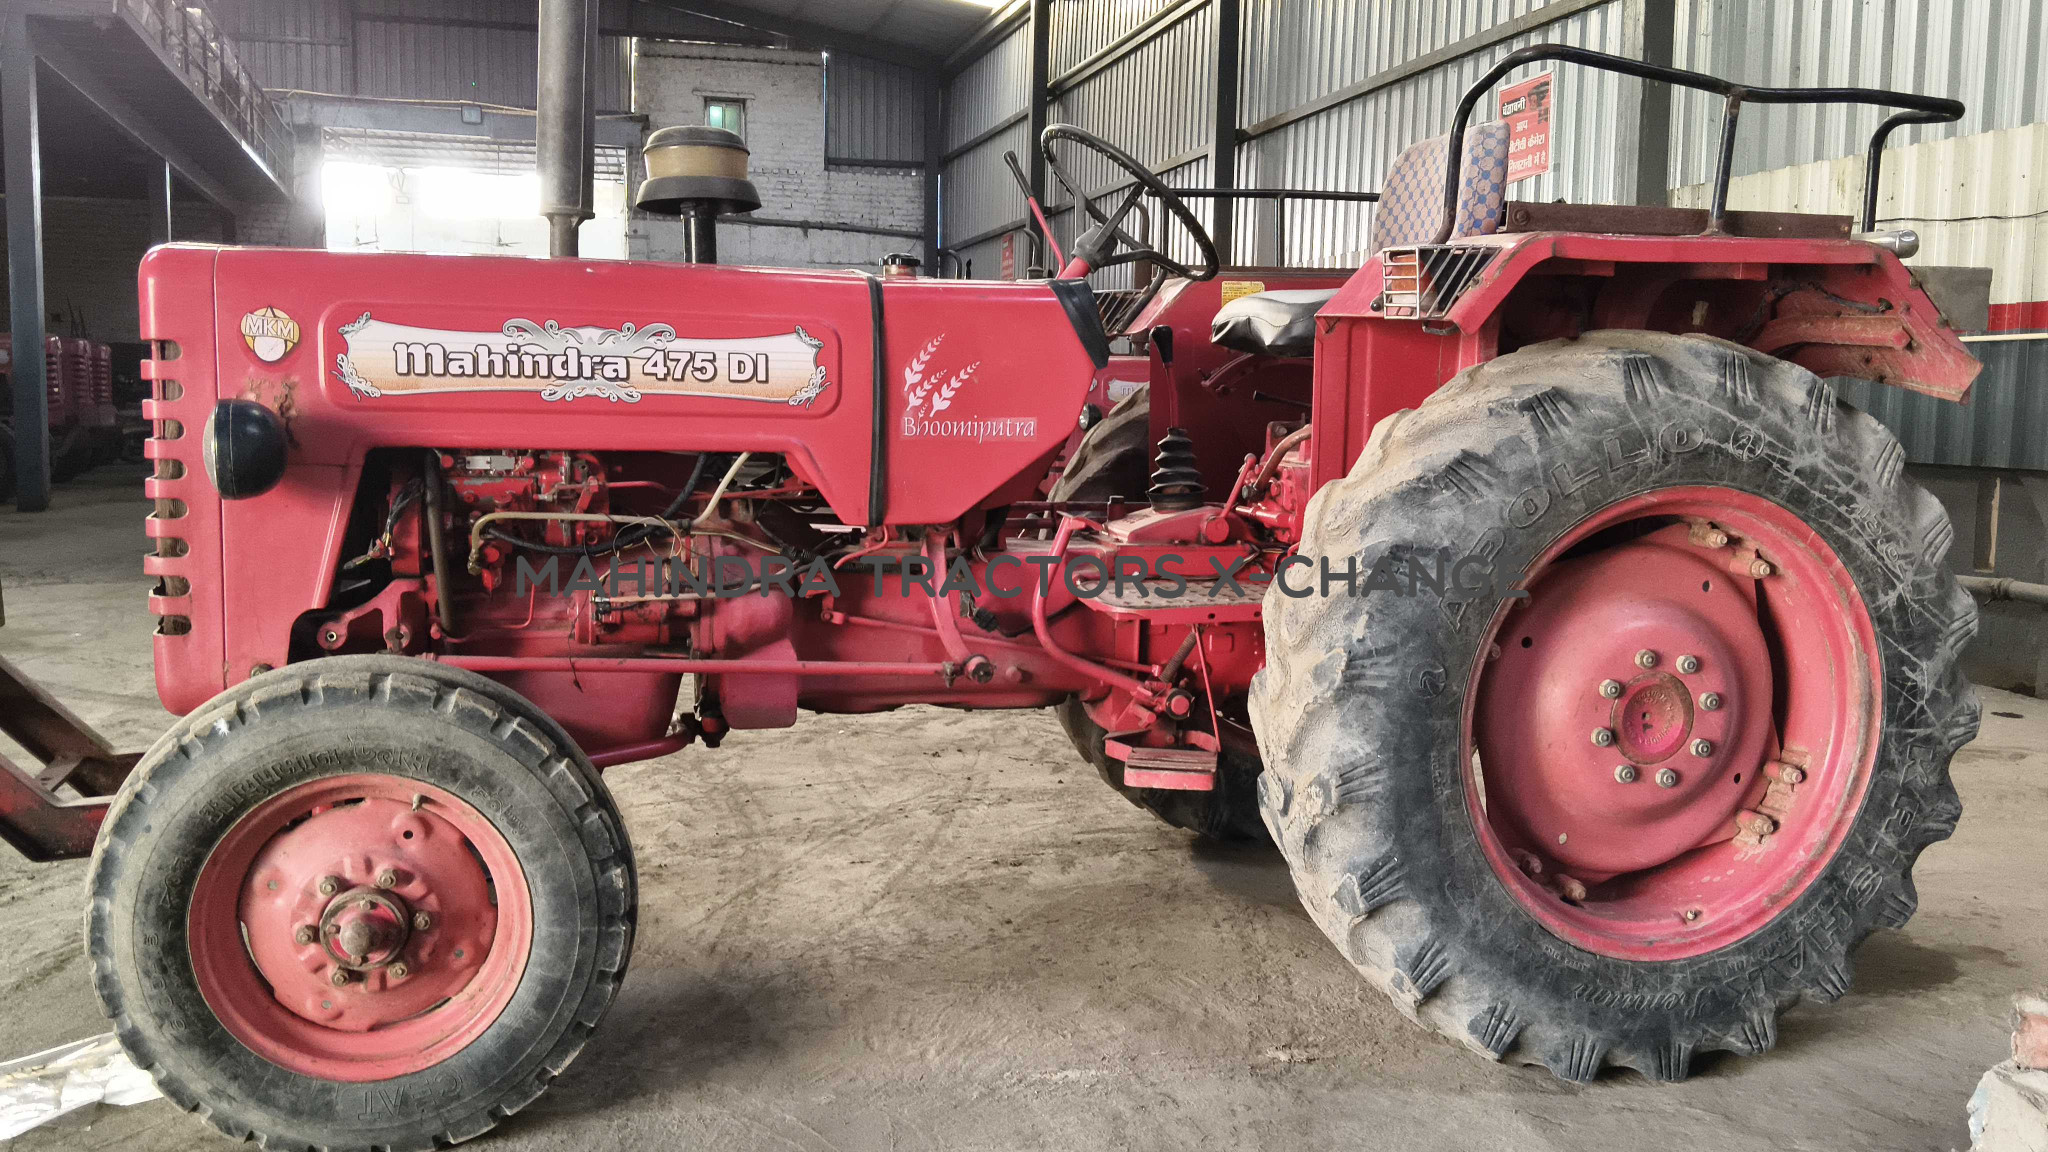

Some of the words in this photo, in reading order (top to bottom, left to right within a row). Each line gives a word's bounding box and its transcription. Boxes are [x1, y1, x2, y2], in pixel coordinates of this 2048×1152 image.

[244, 315, 295, 341] MKM
[393, 342, 630, 381] Mahindra
[642, 348, 717, 382] 475
[728, 352, 770, 382] DI
[903, 415, 1036, 444] Bhoomiputra
[1438, 419, 1704, 634] APOLLO
[357, 1067, 463, 1121] CEAT
